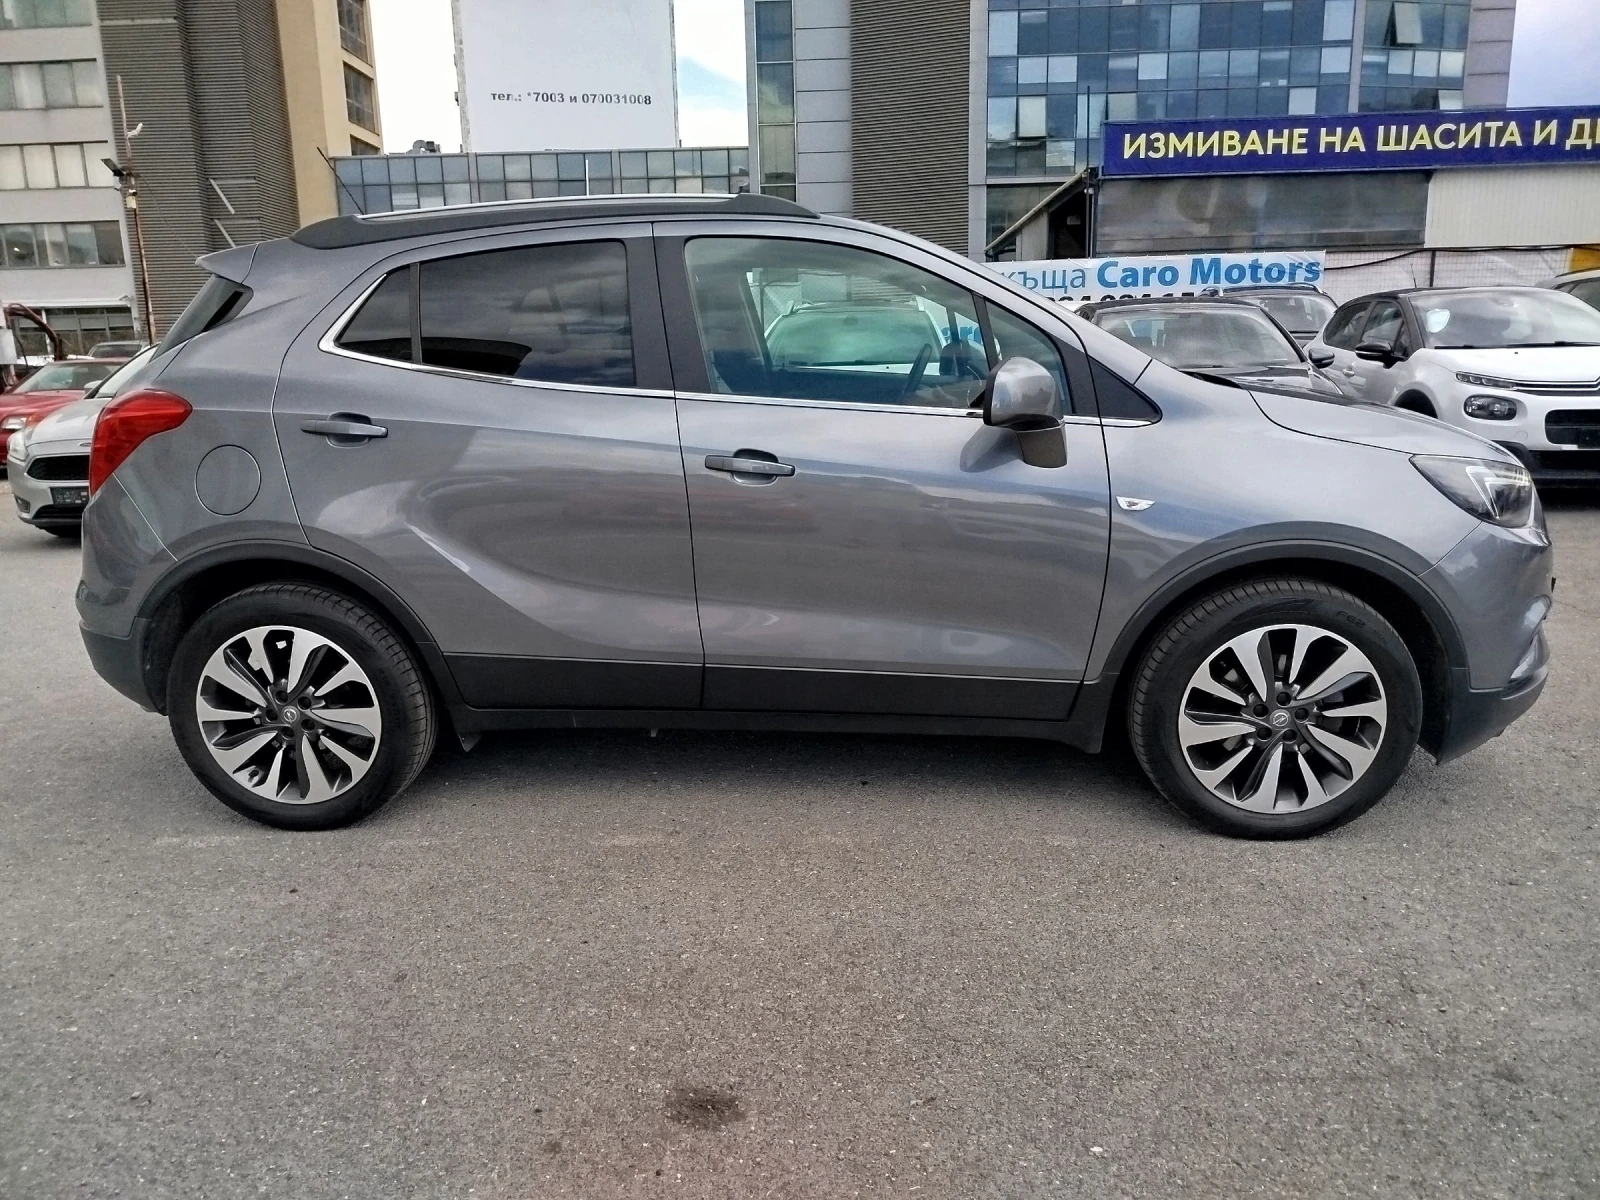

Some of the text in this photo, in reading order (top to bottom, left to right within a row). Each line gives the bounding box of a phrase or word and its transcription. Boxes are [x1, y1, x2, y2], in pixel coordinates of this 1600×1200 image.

[569, 95, 578, 104] и
[581, 93, 652, 106] 070031008
[1123, 118, 1600, 159] ИЗМИВАНЕ НА ШАСИТА И Д
[1097, 260, 1180, 288] Caro
[1189, 257, 1321, 285] Motors
